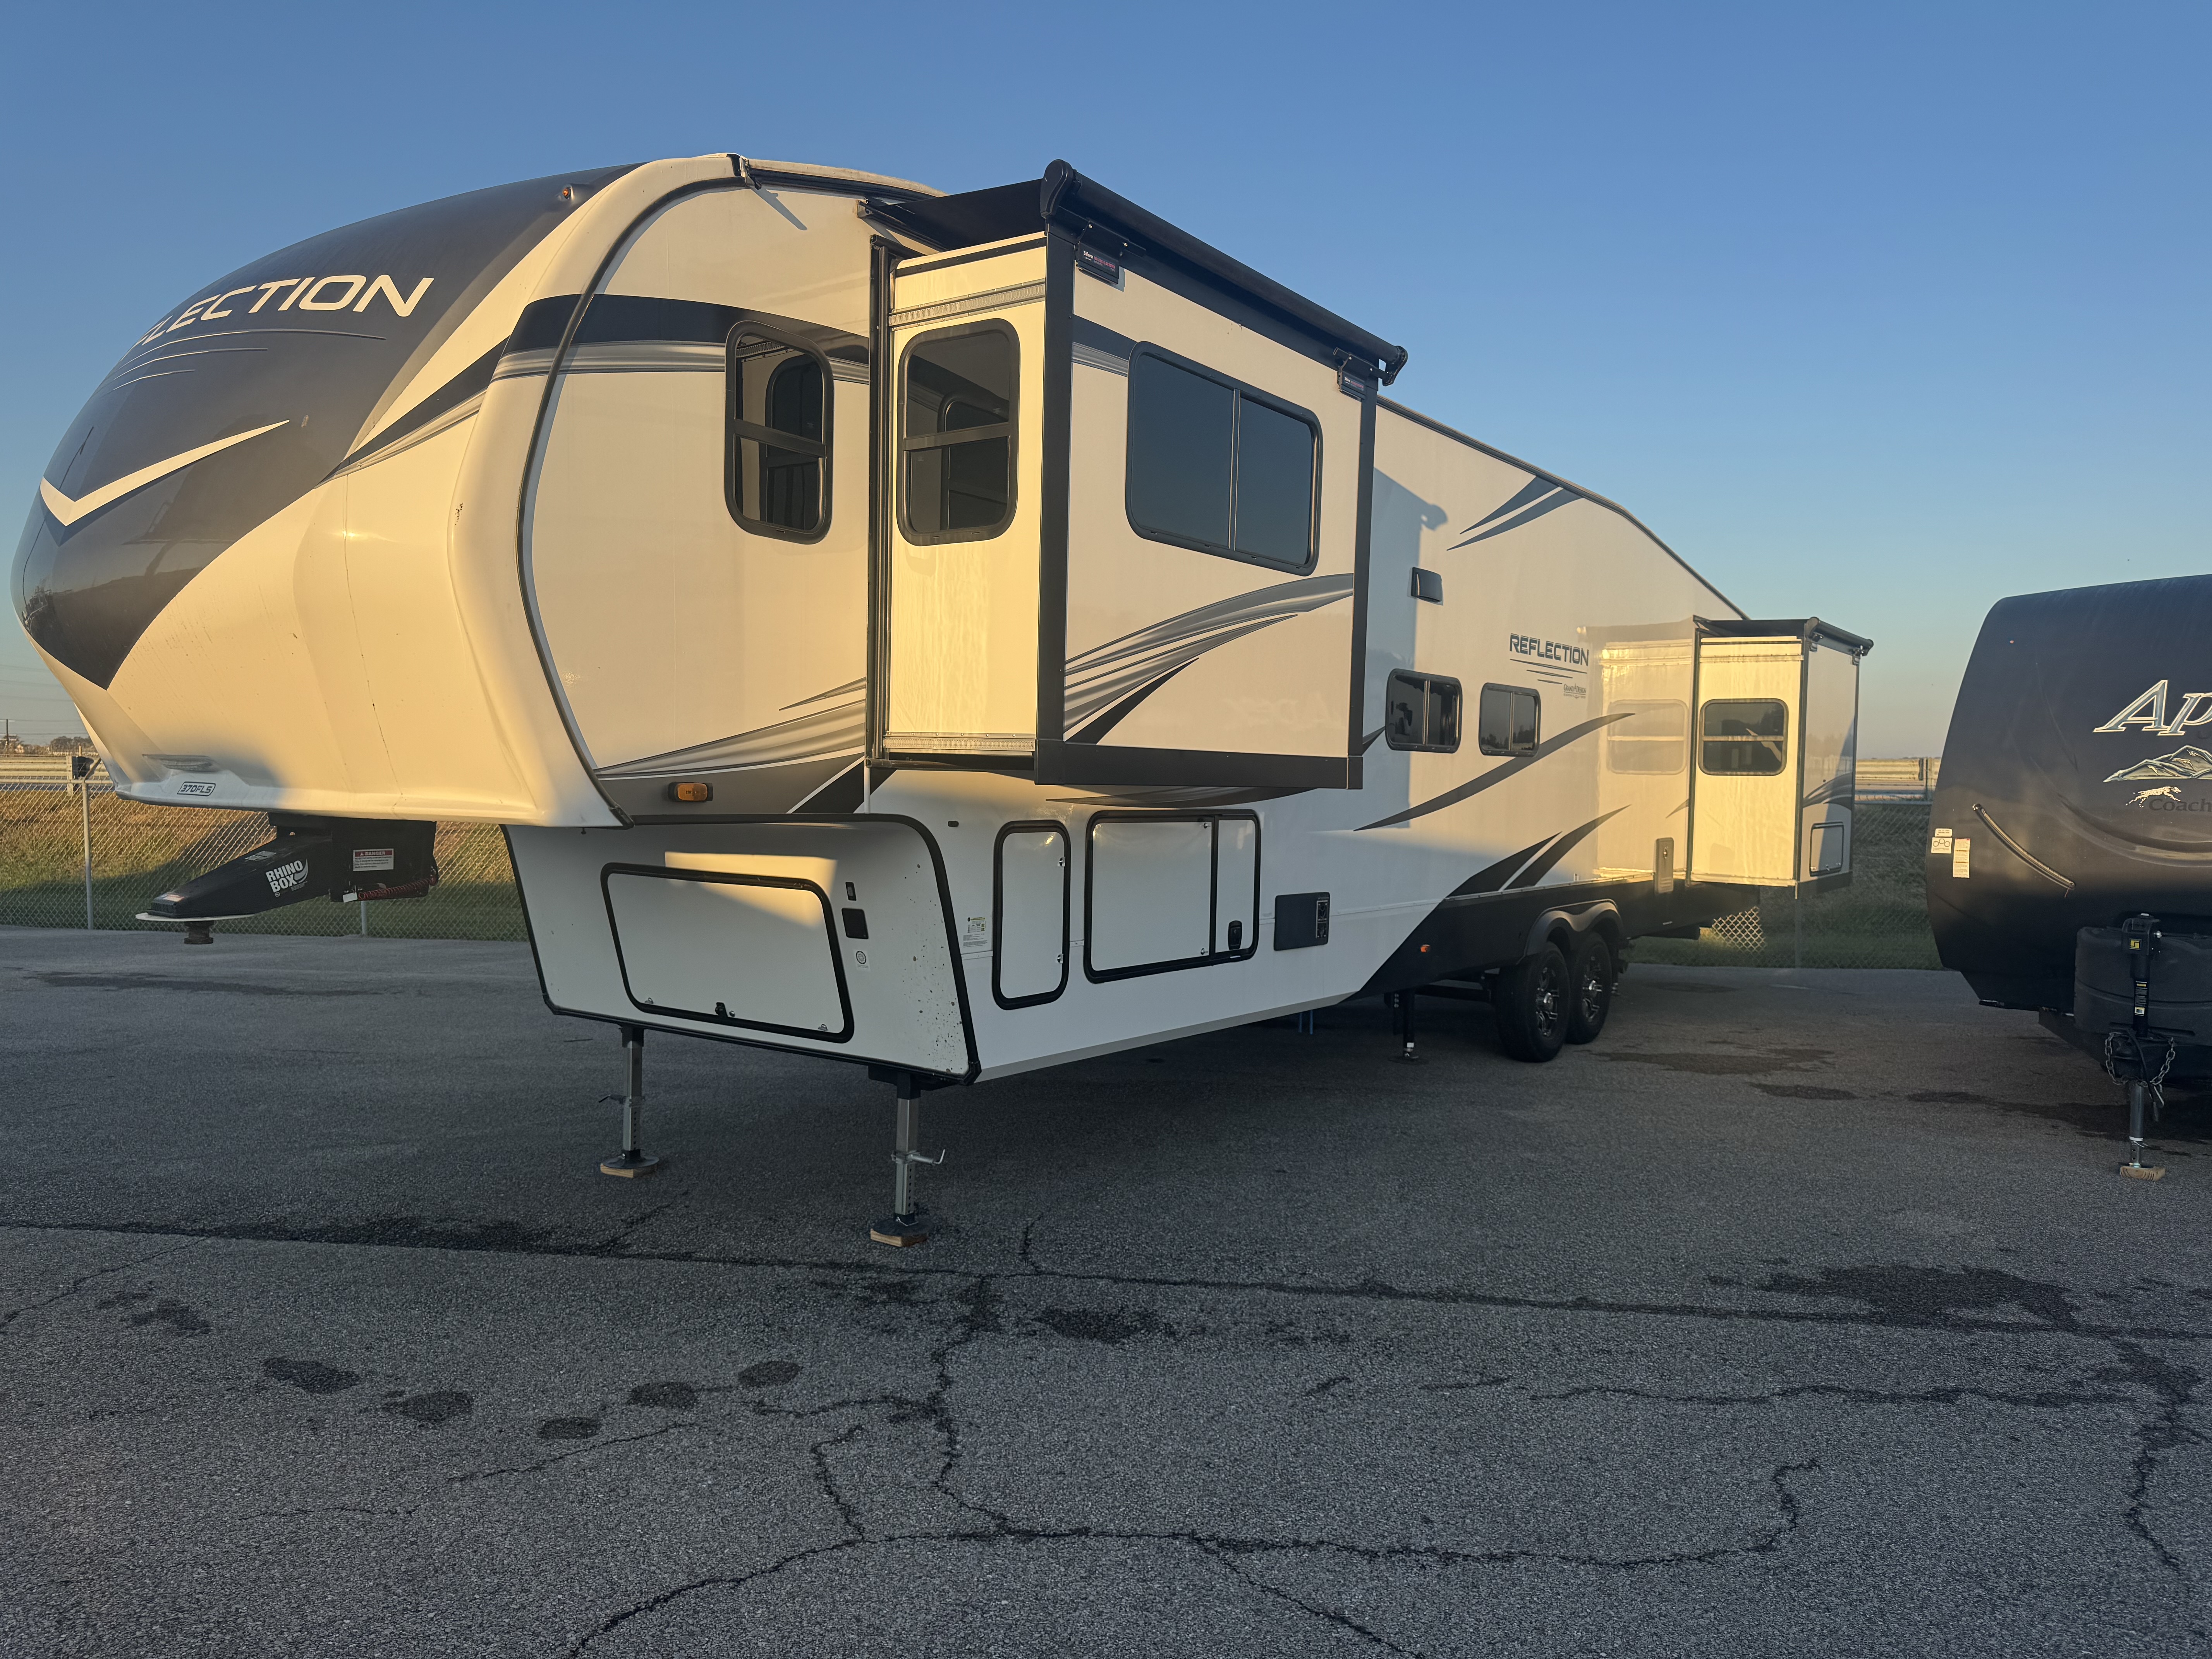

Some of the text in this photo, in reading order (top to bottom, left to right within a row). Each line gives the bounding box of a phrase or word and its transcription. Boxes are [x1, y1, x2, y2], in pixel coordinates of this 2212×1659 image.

[1510, 633, 1589, 666] REFLECTION
[180, 785, 213, 793] 370FLS
[266, 860, 303, 882] RHINO
[270, 874, 297, 893] BOX
